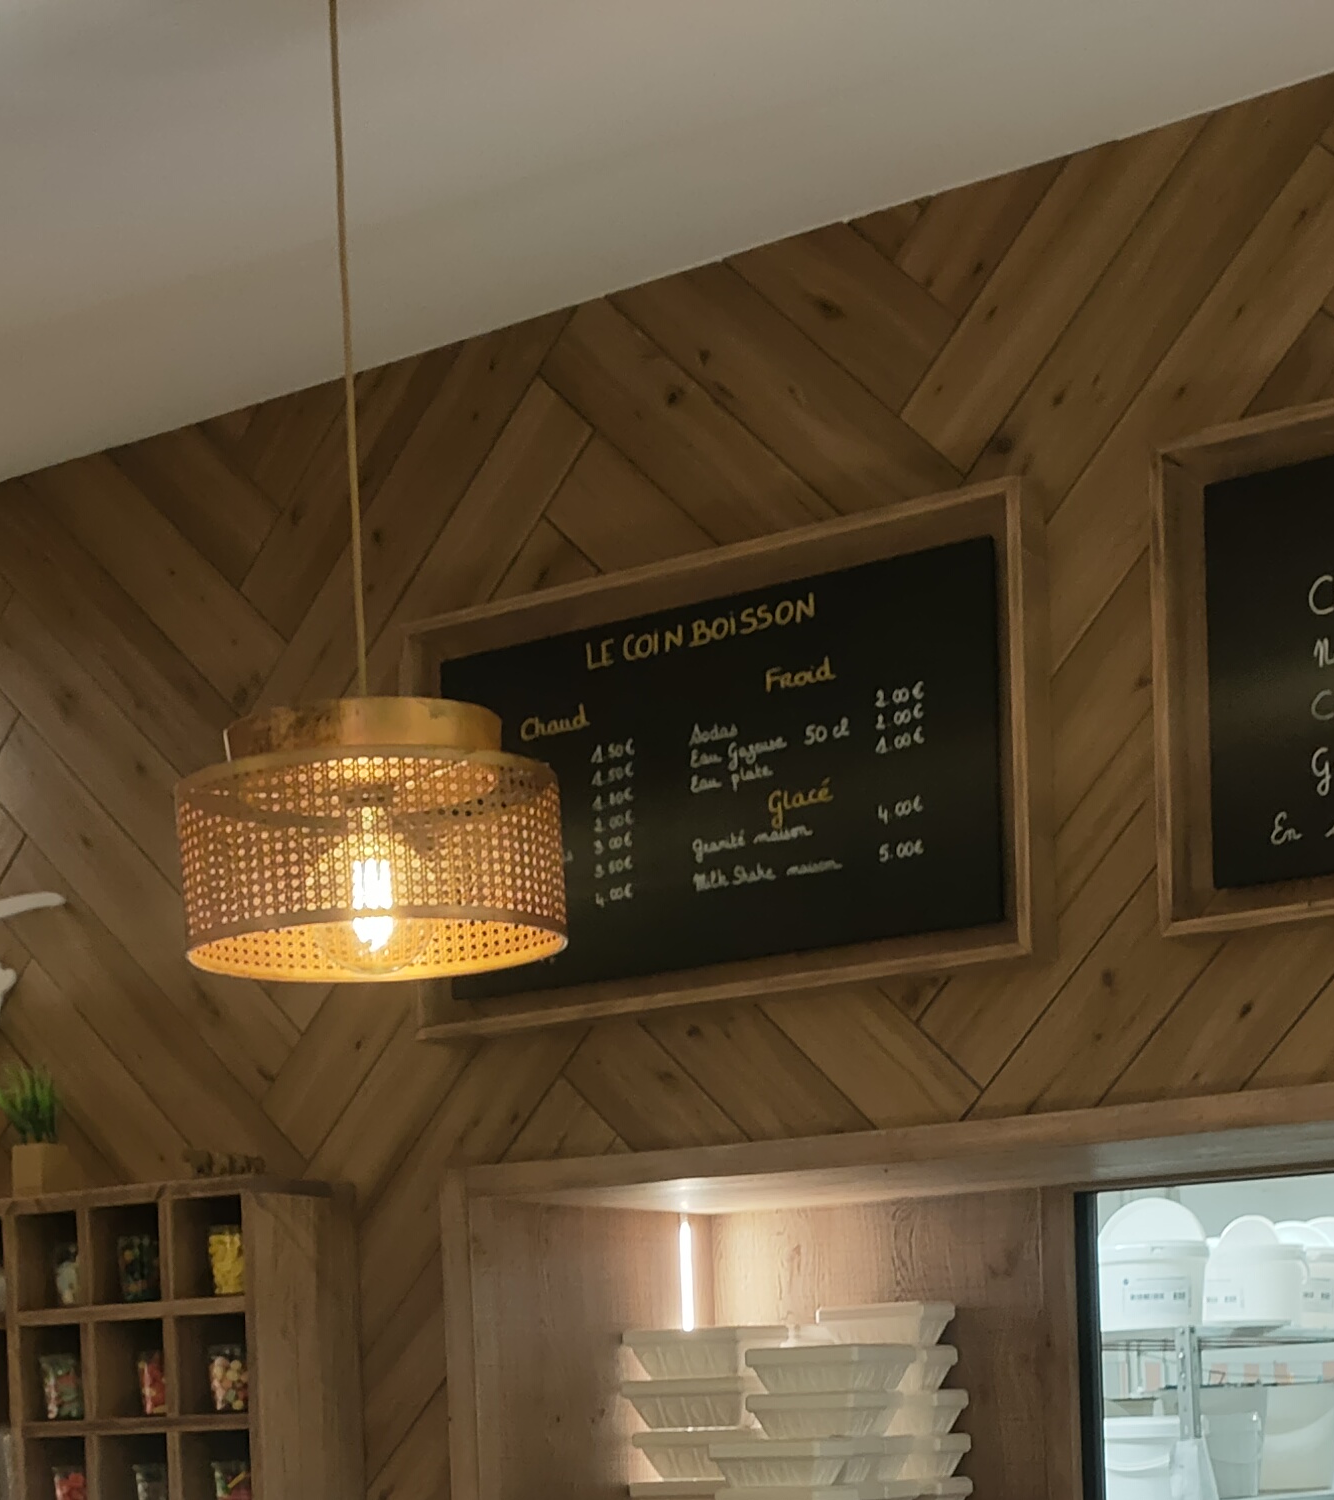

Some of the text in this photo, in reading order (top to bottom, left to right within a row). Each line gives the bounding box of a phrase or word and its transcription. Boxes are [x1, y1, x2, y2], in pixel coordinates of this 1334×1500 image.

[585, 638, 615, 672] LE
[623, 624, 683, 662] COIN
[765, 655, 836, 692] Froid
[520, 702, 590, 741] Chaud
[690, 749, 722, 768] Eau
[804, 724, 827, 745] 50
[690, 775, 722, 793] Eau
[731, 764, 774, 792] plate
[768, 776, 834, 829] Glacé
[1270, 811, 1302, 845] En
